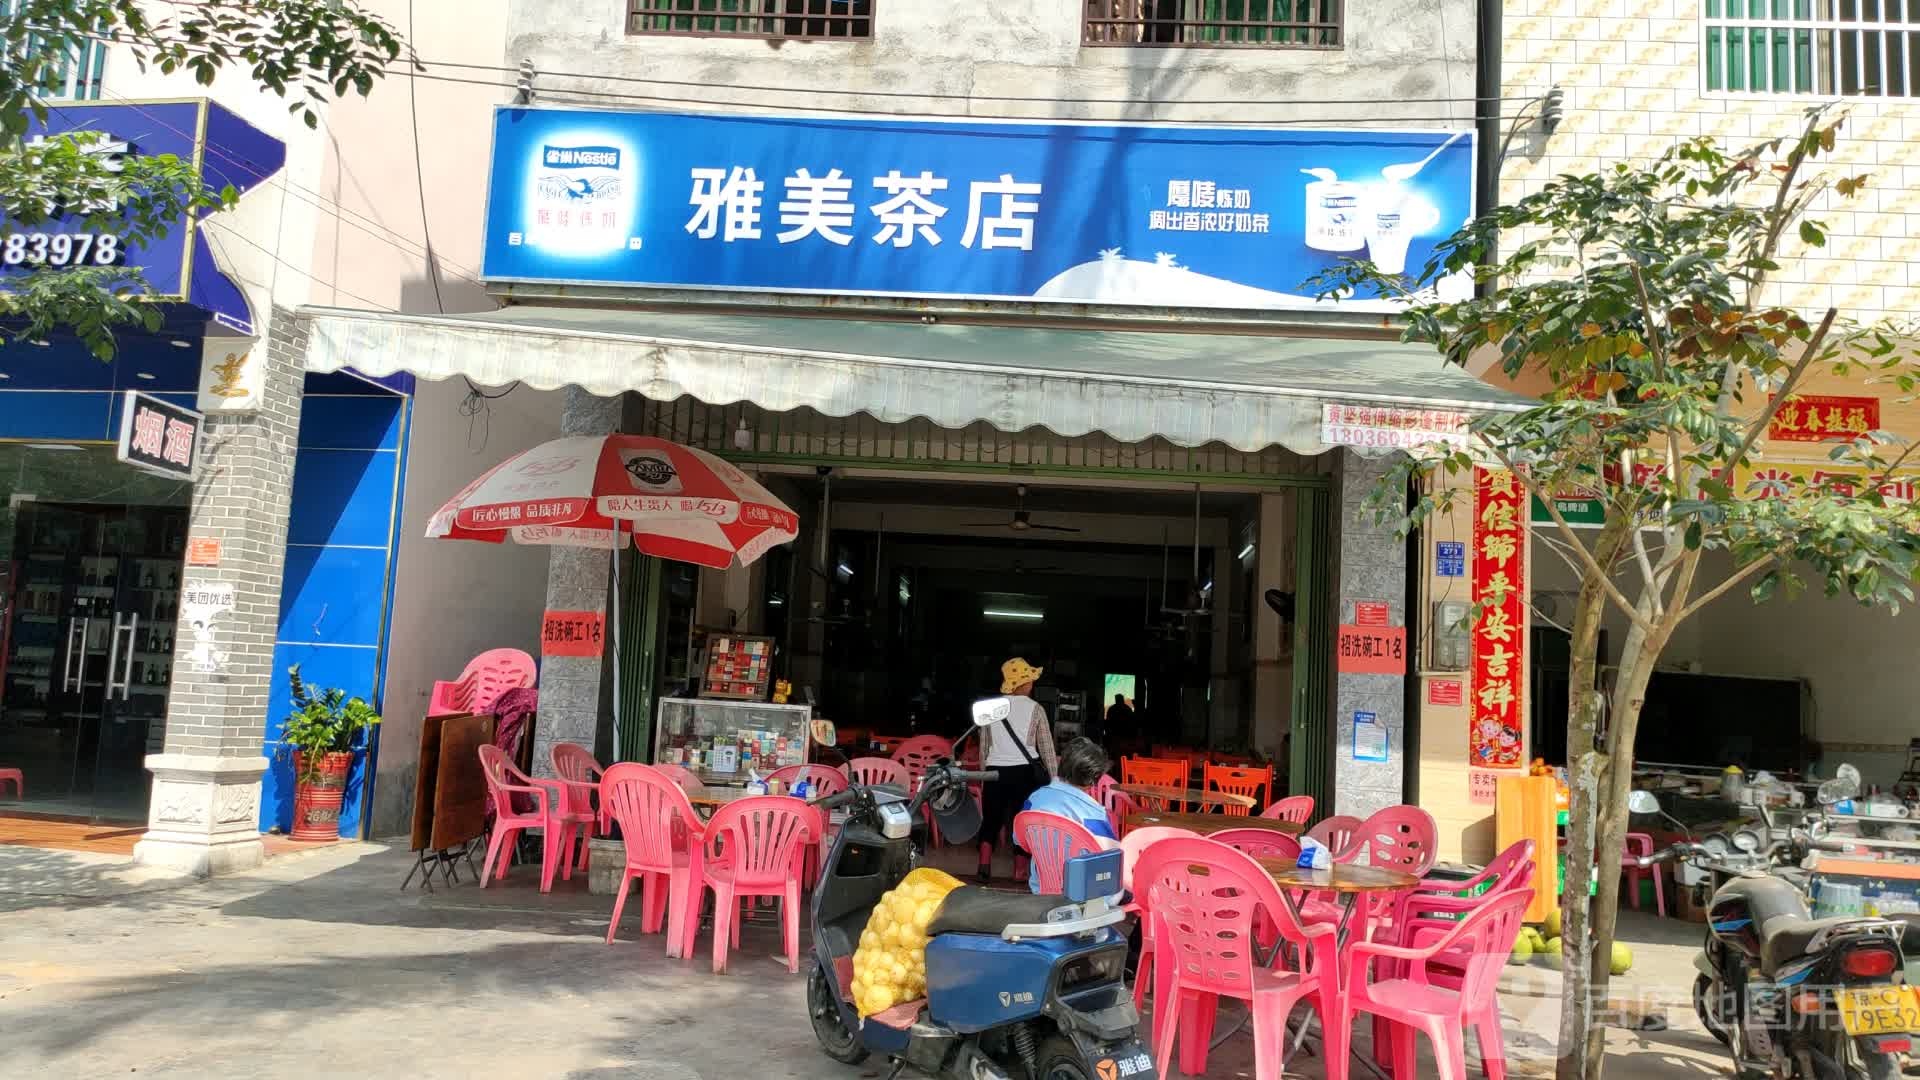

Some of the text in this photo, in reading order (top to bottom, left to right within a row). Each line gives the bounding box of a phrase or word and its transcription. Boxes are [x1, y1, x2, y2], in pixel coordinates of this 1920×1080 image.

[684, 165, 1043, 251] 雅美茶店
[1149, 210, 1269, 233] 调出香浓好奶茶
[0, 233, 118, 265] 83978
[132, 406, 194, 467] 烟酒
[527, 503, 572, 519] 品质非凡
[185, 591, 233, 607] 美团优选
[544, 619, 601, 642] 招洗碗工1名
[1341, 634, 1402, 660] 招洗碗工1名
[1117, 1053, 1153, 1078] 雅迪
